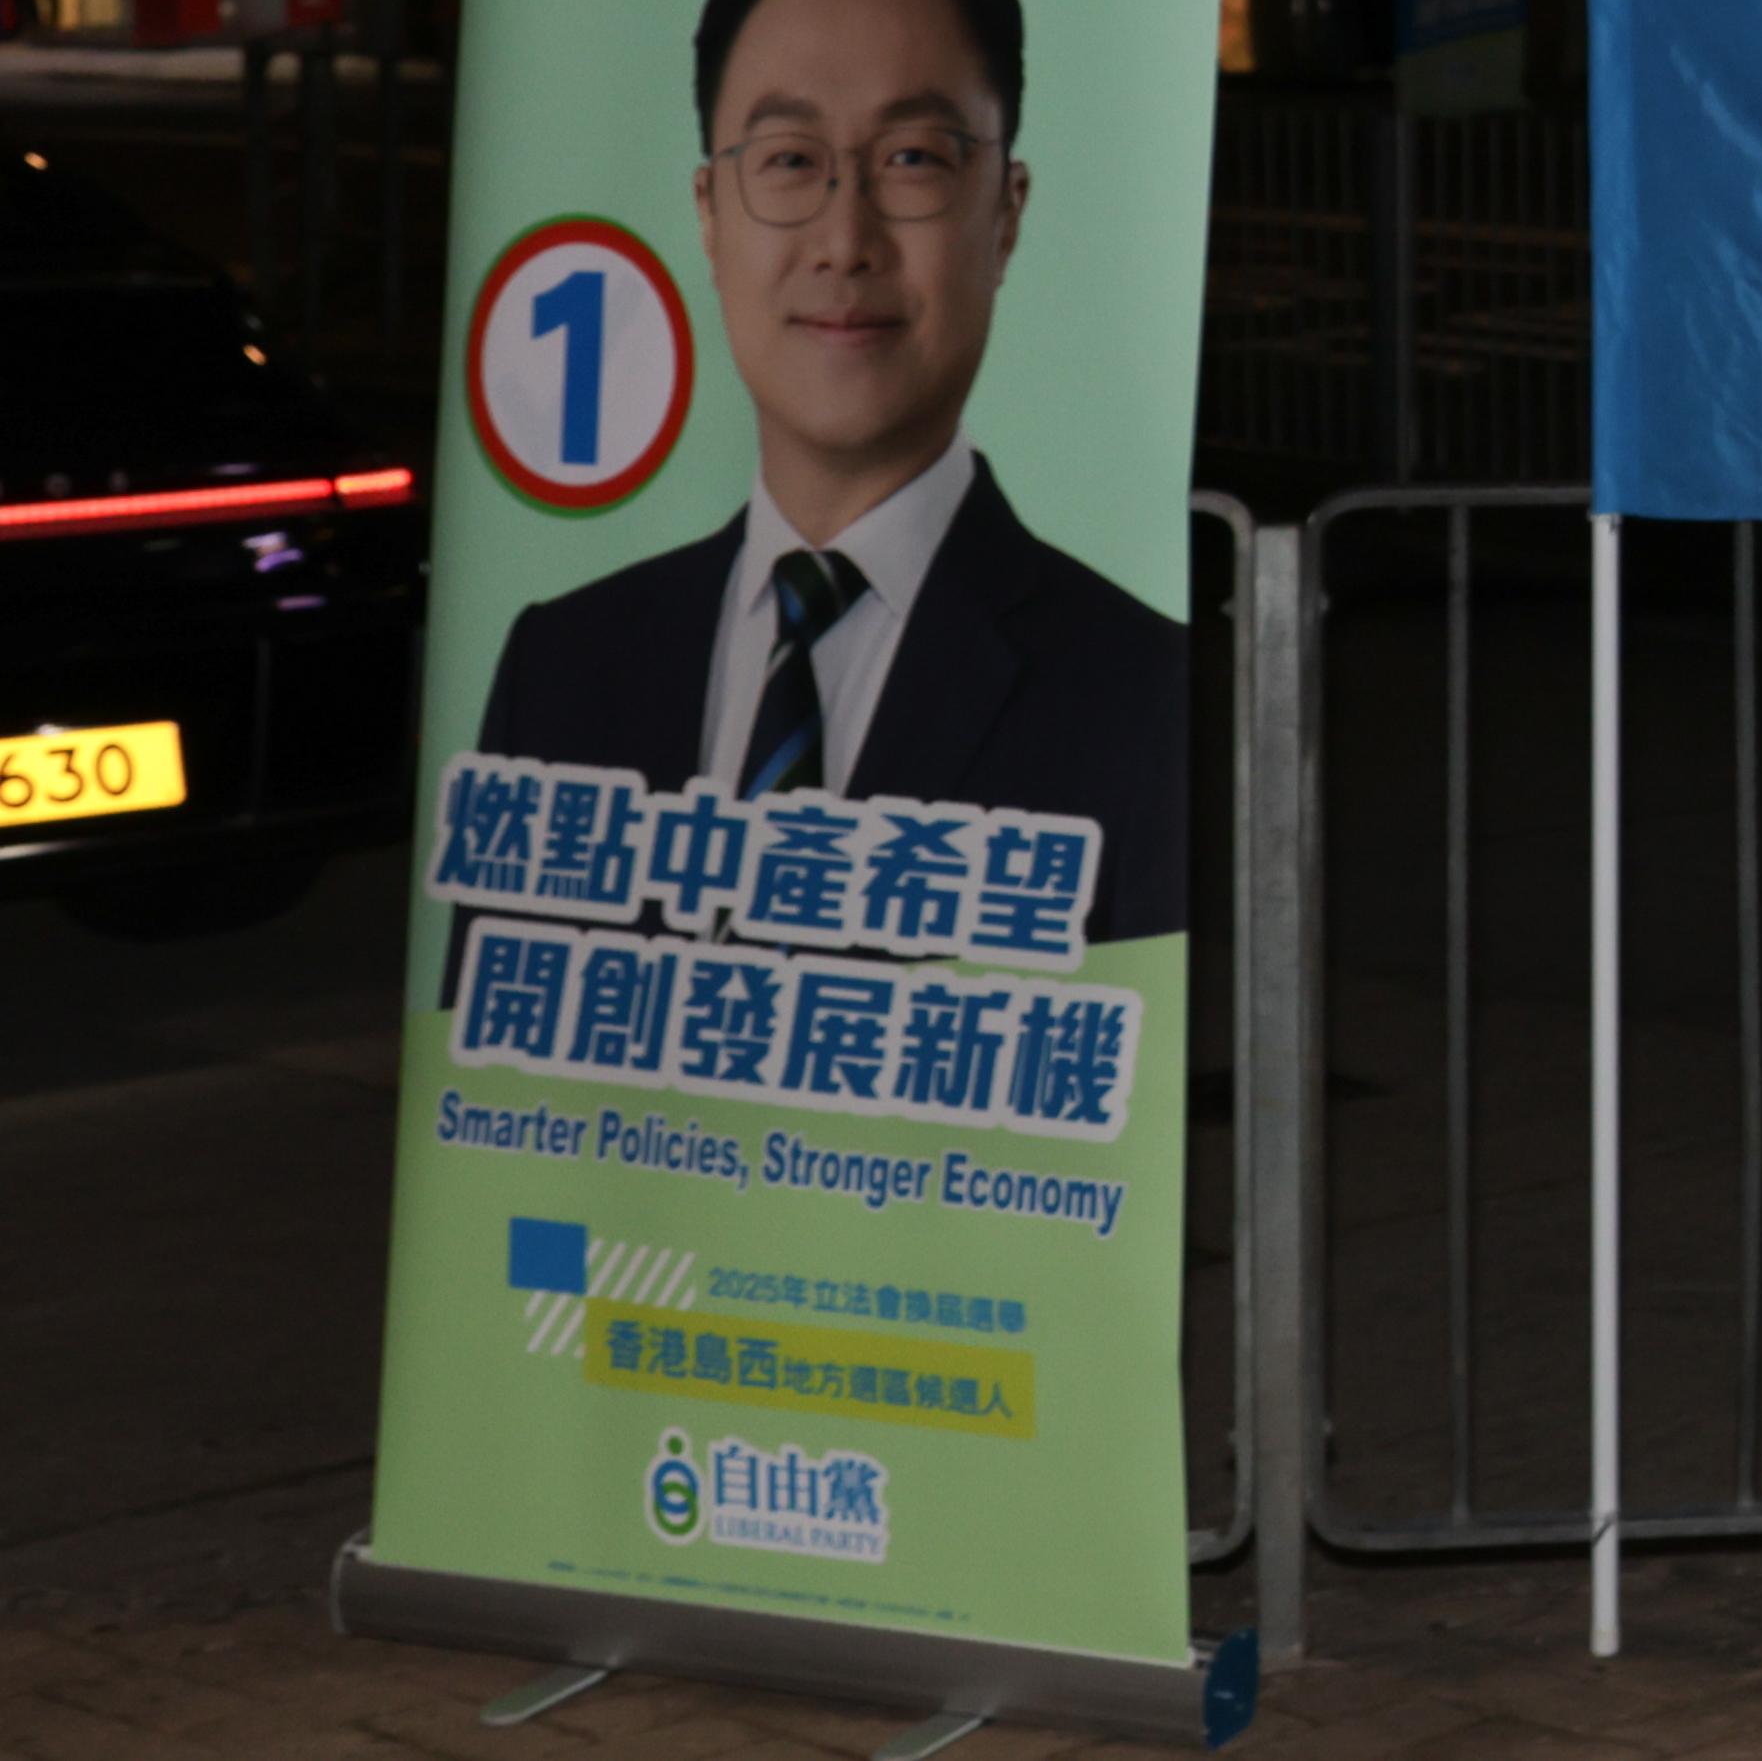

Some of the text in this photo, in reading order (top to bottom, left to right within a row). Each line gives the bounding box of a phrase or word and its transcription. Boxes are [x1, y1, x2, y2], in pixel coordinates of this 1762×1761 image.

[532, 271, 606, 465] 1
[436, 767, 1087, 957] 燃點中產希望
[462, 934, 1125, 1125] 開創發展新機
[437, 1090, 1125, 1235] Smarter Policies, Stronger Economy
[607, 1319, 1014, 1419] 香港島西地方選區候選人
[714, 1444, 880, 1525] 自由黨
[715, 1516, 881, 1556] LIBERAL PARTY
